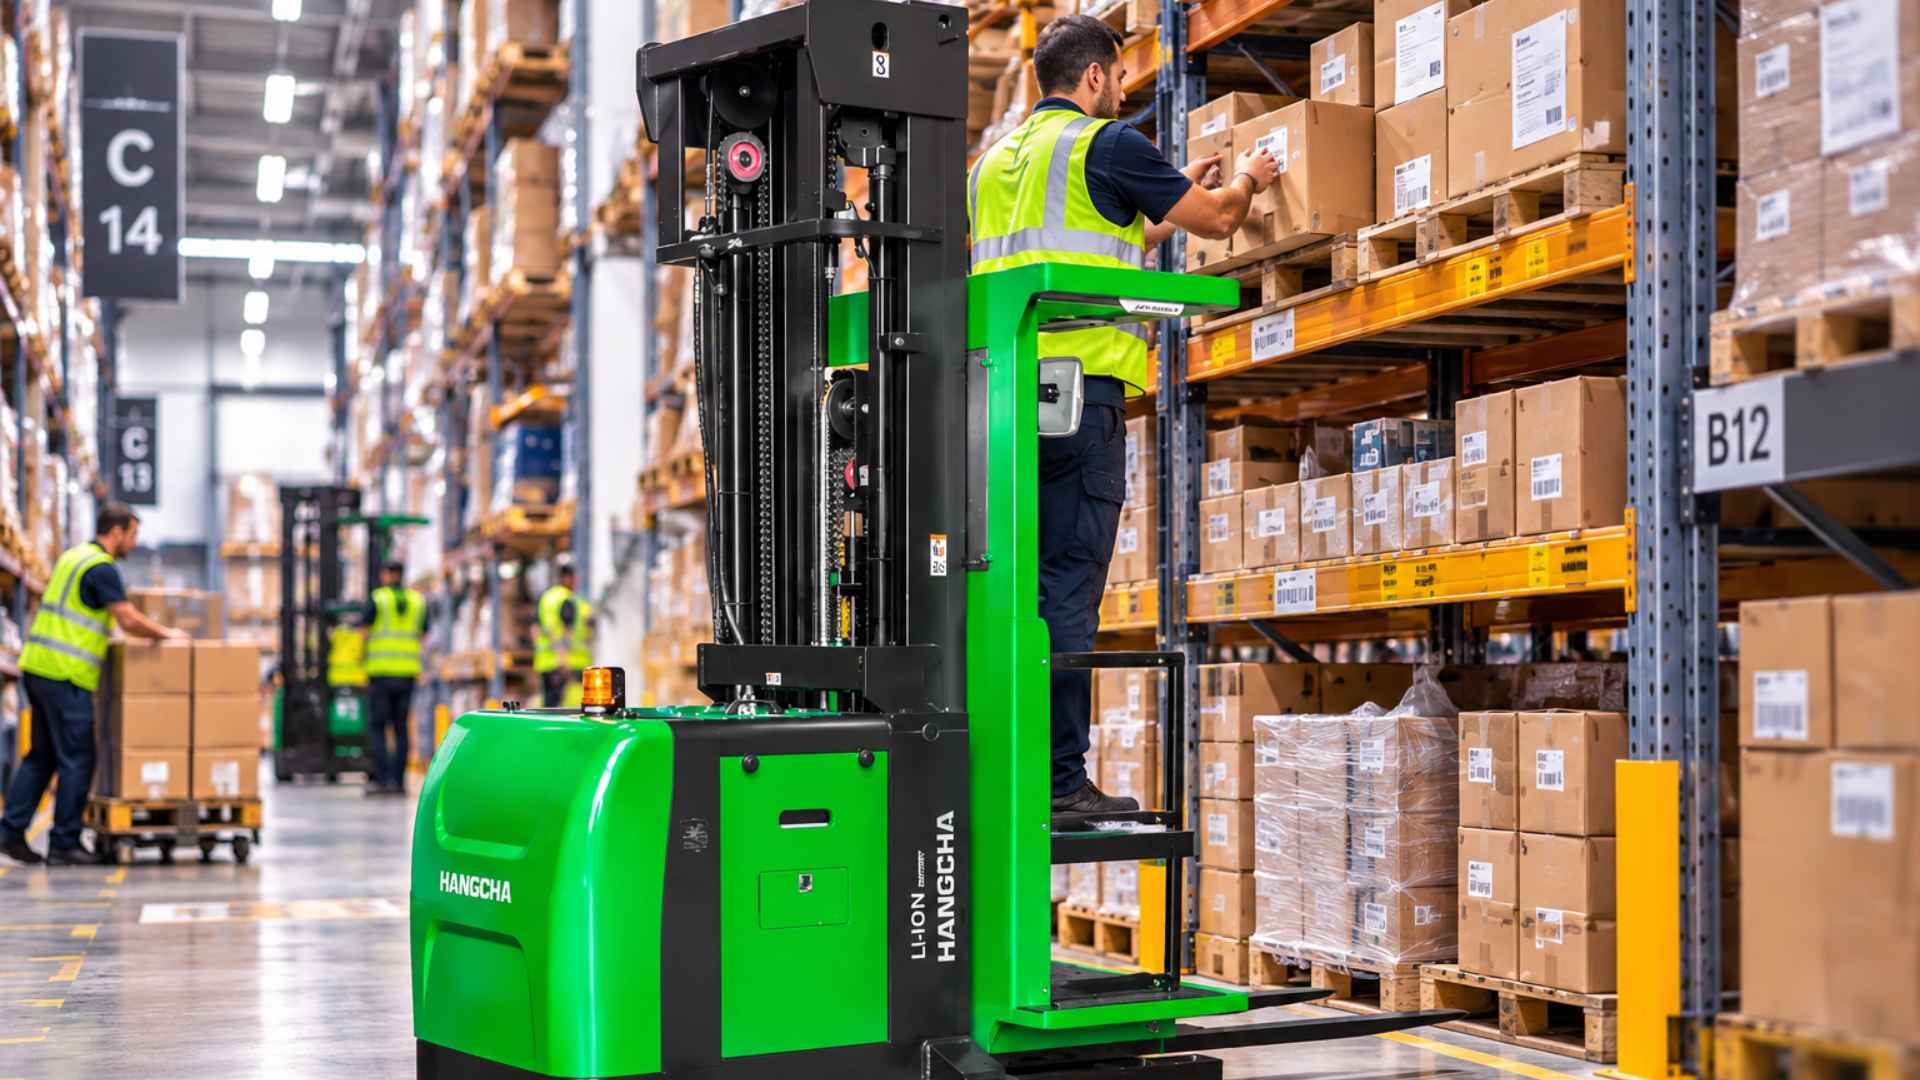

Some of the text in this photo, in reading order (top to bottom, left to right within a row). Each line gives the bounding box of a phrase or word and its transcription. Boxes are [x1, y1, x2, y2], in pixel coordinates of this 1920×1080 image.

[107, 128, 154, 187] C
[99, 204, 163, 254] 14
[121, 426, 149, 460] C
[1708, 404, 1770, 467] B12
[439, 870, 512, 904] HANGCHA
[937, 810, 956, 963] HANGCHA
[910, 893, 926, 960] LI-ION
